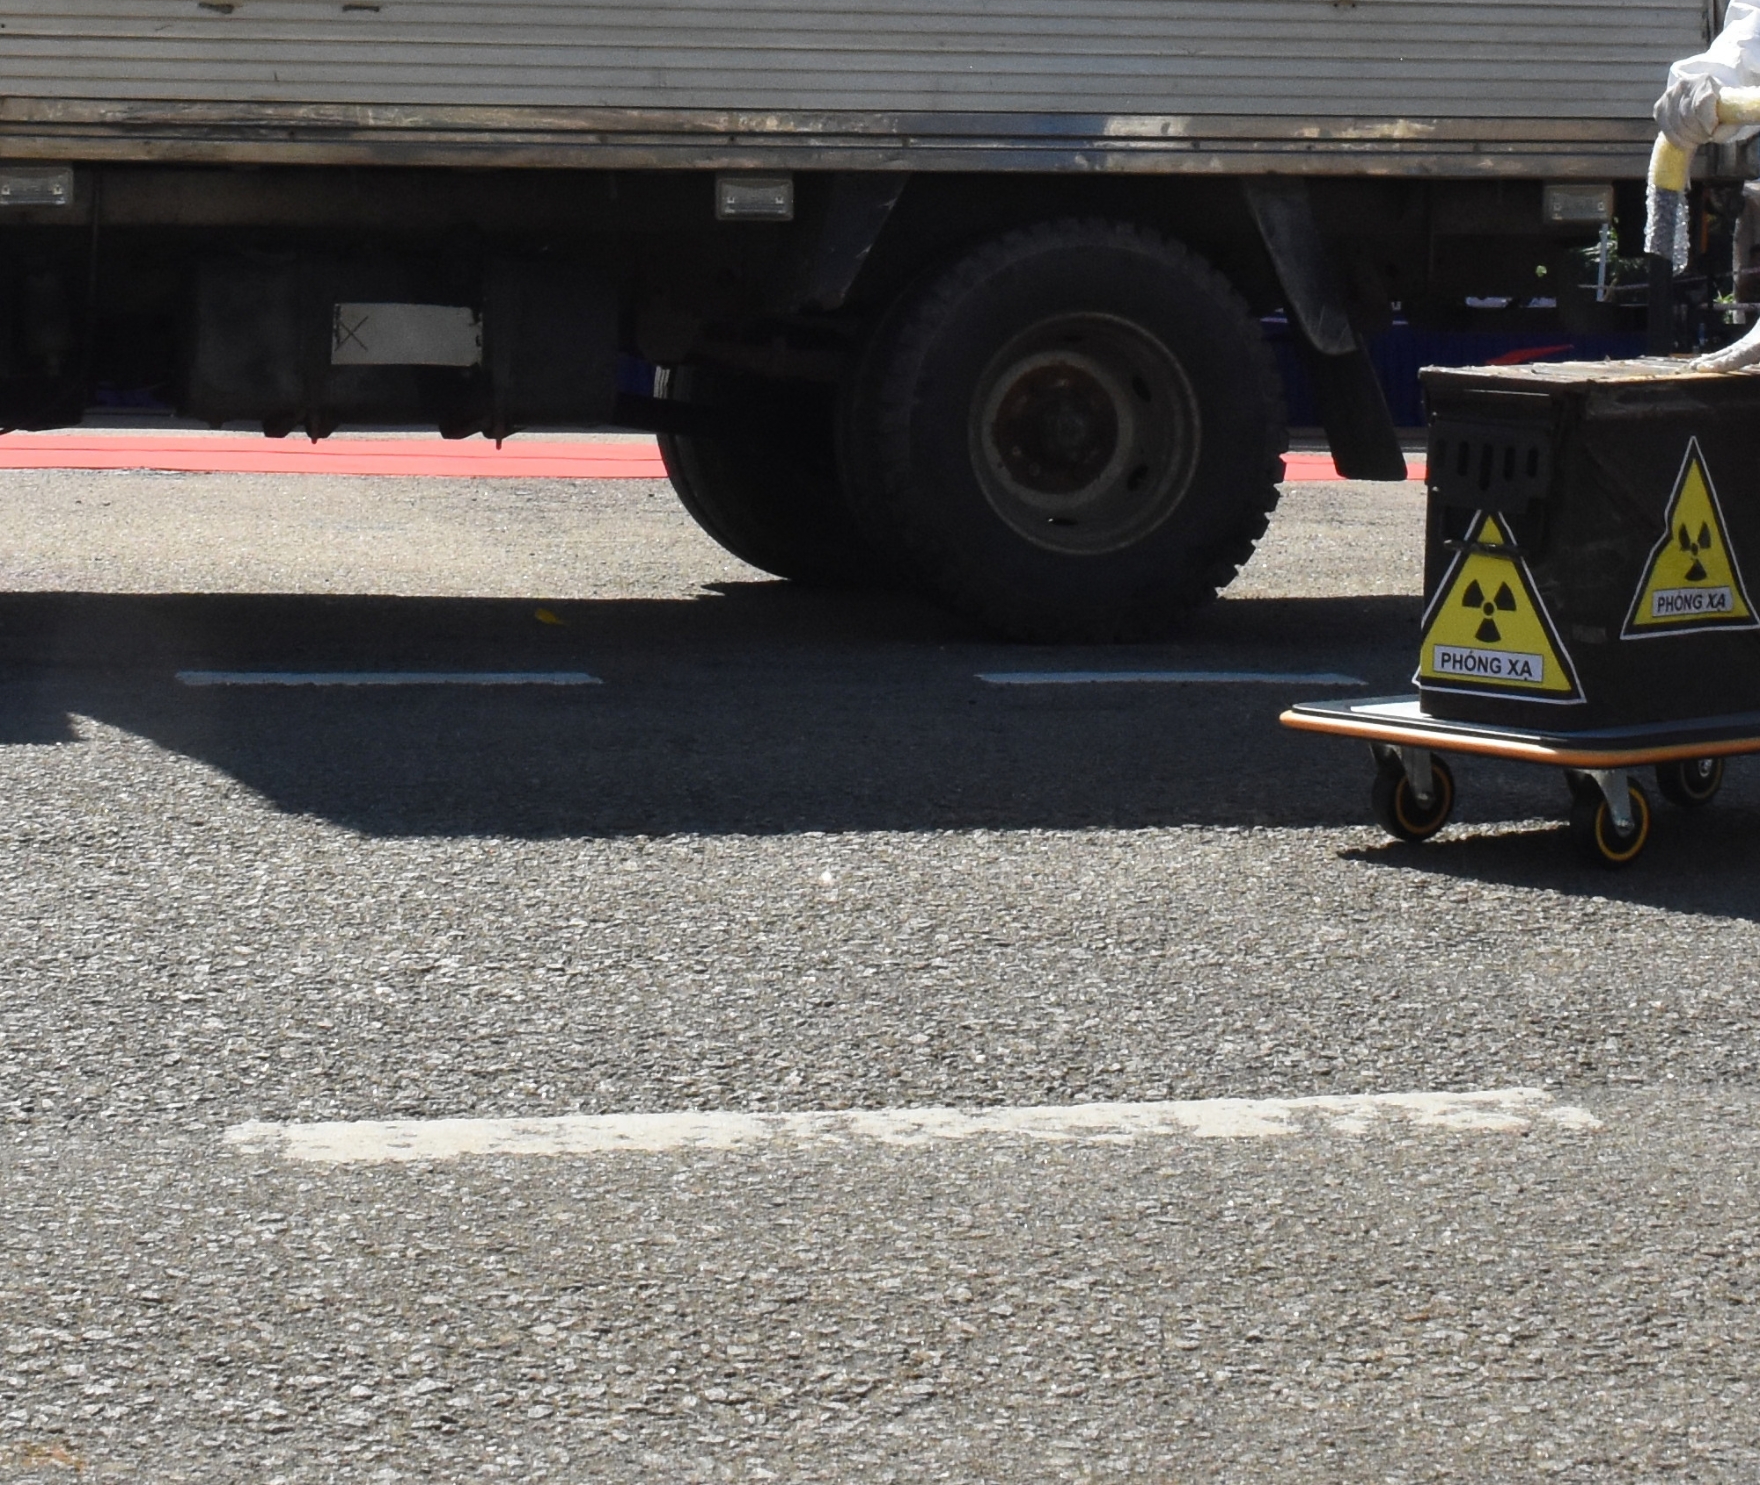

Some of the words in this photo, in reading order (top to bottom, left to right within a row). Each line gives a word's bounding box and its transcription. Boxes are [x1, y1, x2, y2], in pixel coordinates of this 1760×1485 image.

[1656, 591, 1703, 613] PHÓNG
[1706, 593, 1726, 612] XẠ
[1441, 649, 1502, 675] PHÓNG
[1507, 658, 1533, 681] XẠ
